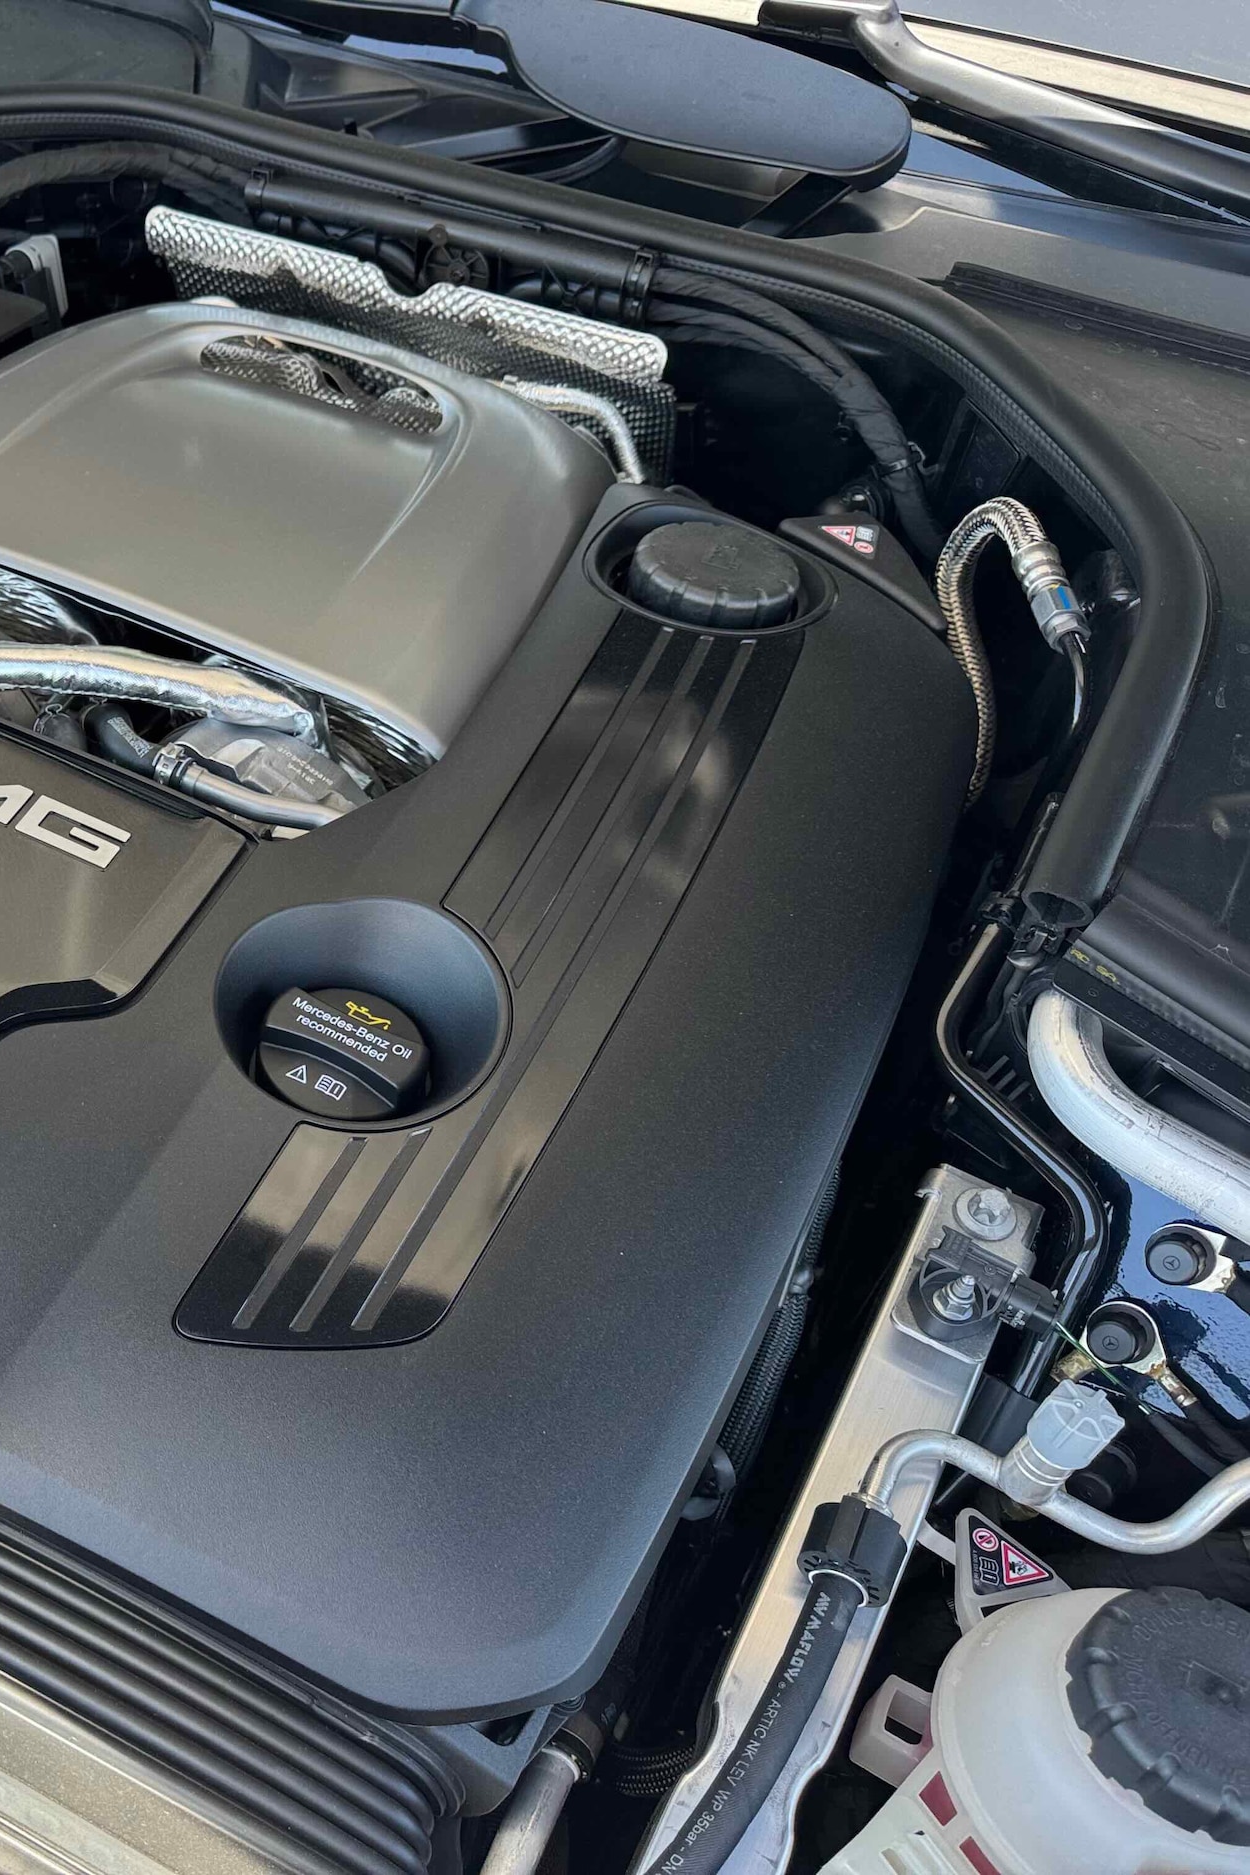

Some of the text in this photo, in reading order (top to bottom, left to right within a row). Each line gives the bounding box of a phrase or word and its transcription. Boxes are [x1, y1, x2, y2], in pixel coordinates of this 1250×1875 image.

[292, 996, 412, 1060] Mercedes-Benz Oil
[296, 1014, 388, 1062] recommended
[783, 1615, 822, 1683] MAFLOW
[754, 1698, 786, 1739] ARTIC
[745, 1742, 762, 1761] NK
[726, 1760, 751, 1787] LEV
[712, 1789, 732, 1812] WP
[684, 1810, 715, 1847] 35bar
